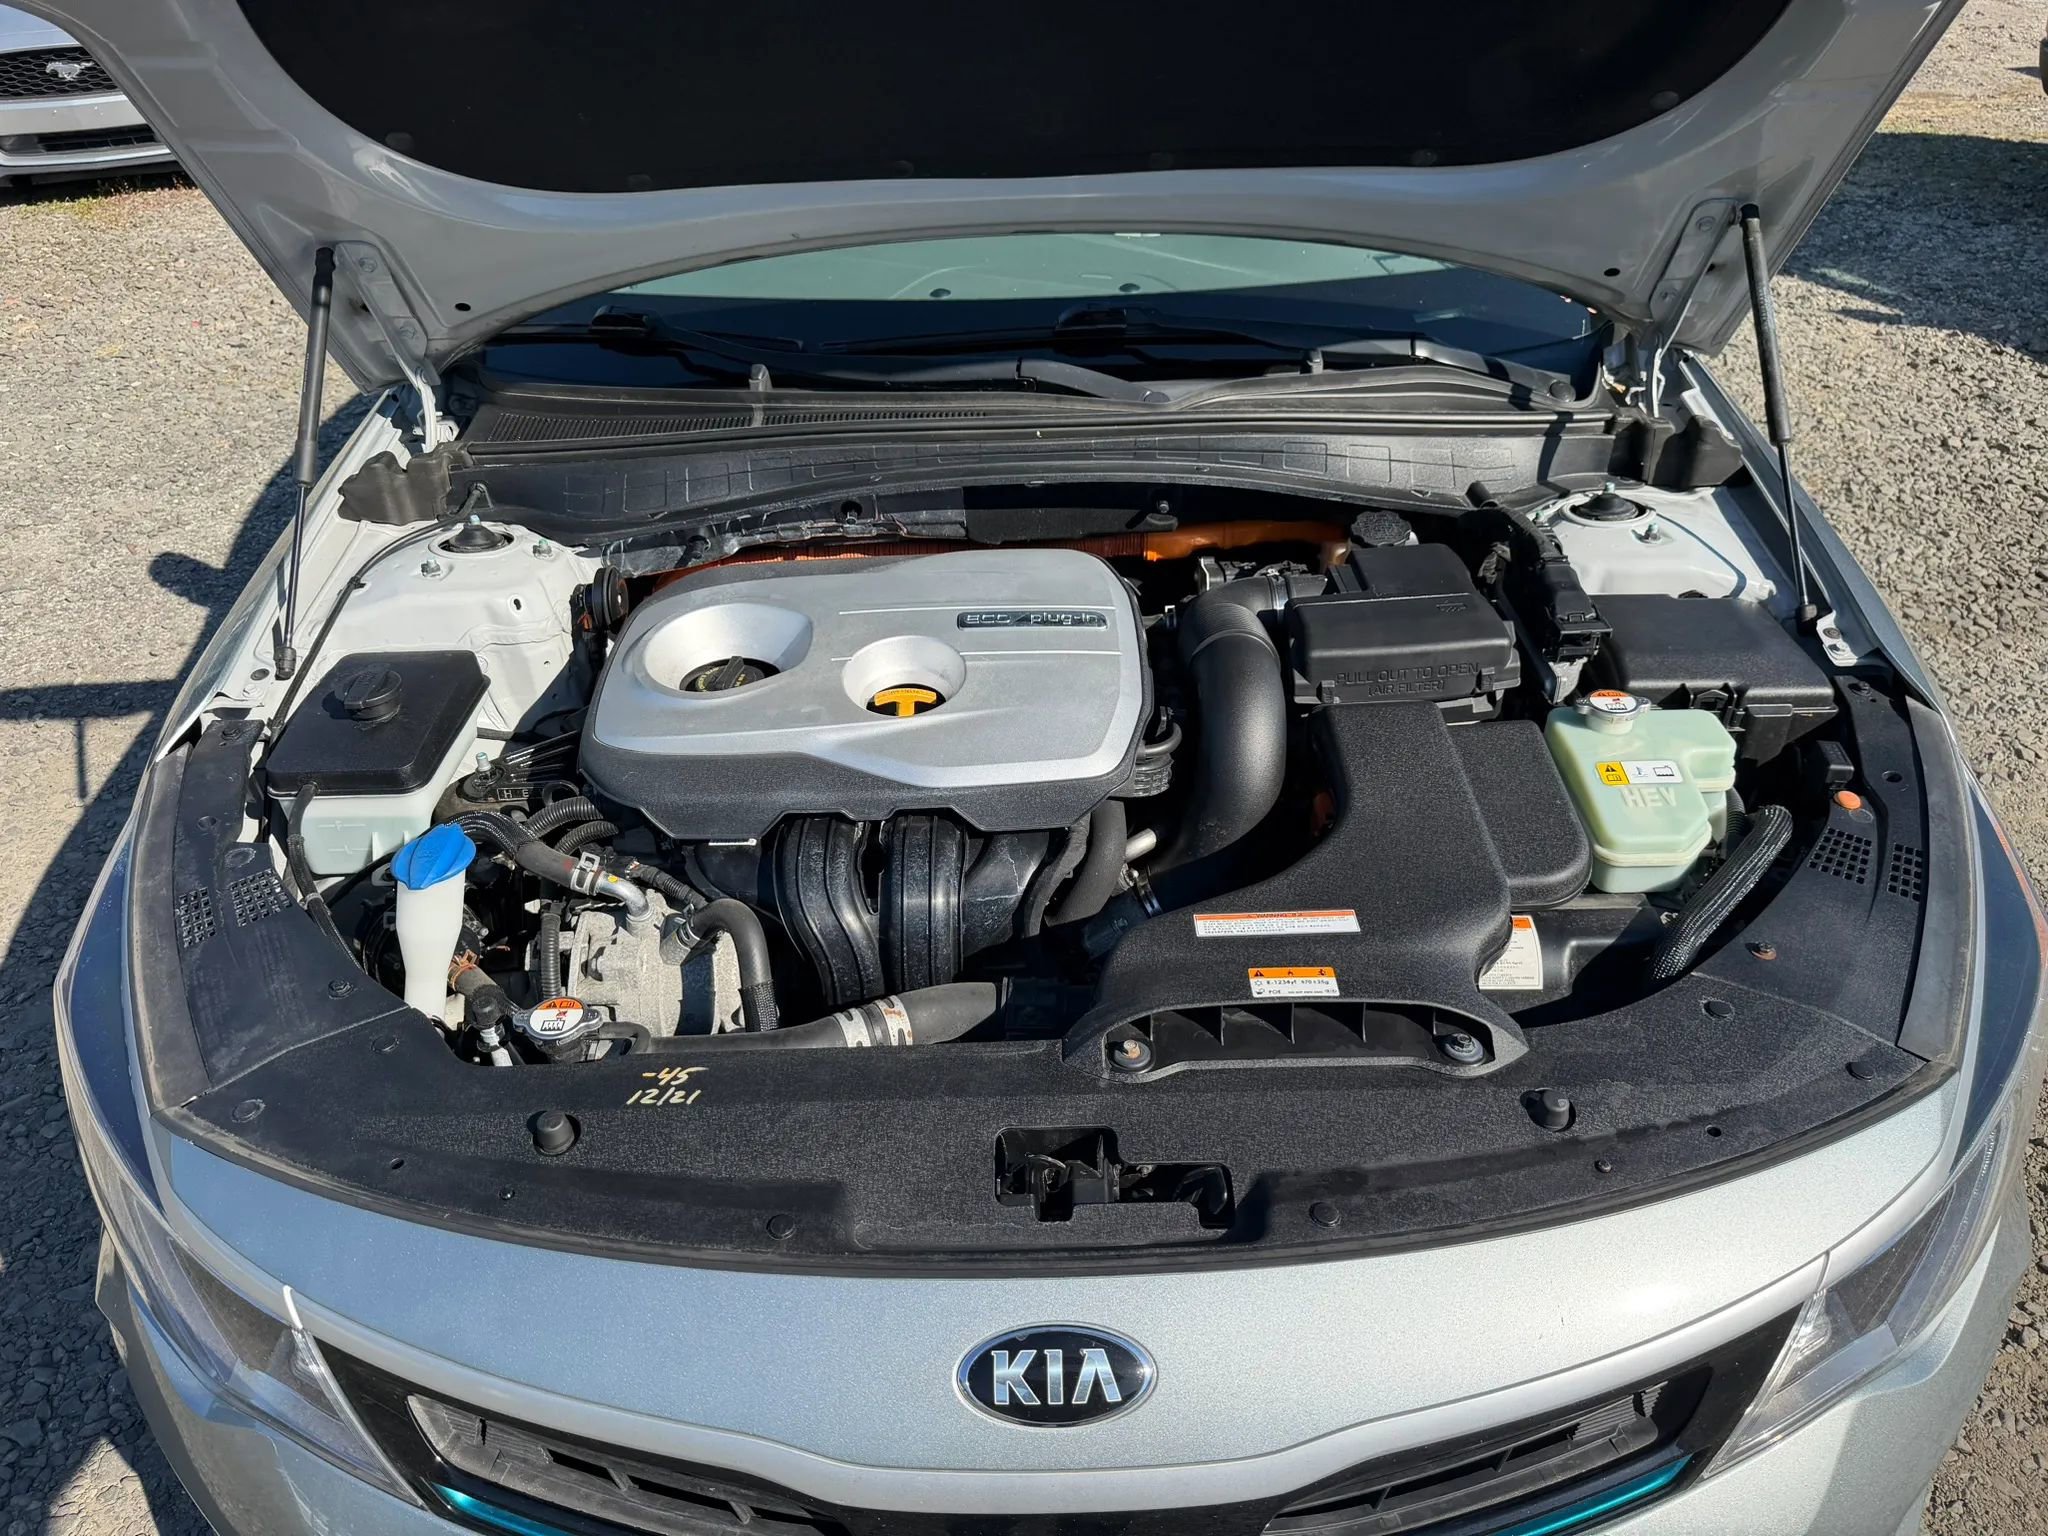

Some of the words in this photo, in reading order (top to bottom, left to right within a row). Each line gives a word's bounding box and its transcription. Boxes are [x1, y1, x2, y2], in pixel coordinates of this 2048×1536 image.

[1336, 672, 1374, 685] PULL
[1378, 668, 1409, 682] OUT
[1412, 667, 1433, 680] TO
[1437, 663, 1479, 678] OPEN
[1619, 786, 1677, 807] HEV
[642, 1066, 709, 1086] -45
[626, 1086, 702, 1107] 12/21
[991, 1348, 1123, 1405] KIA
